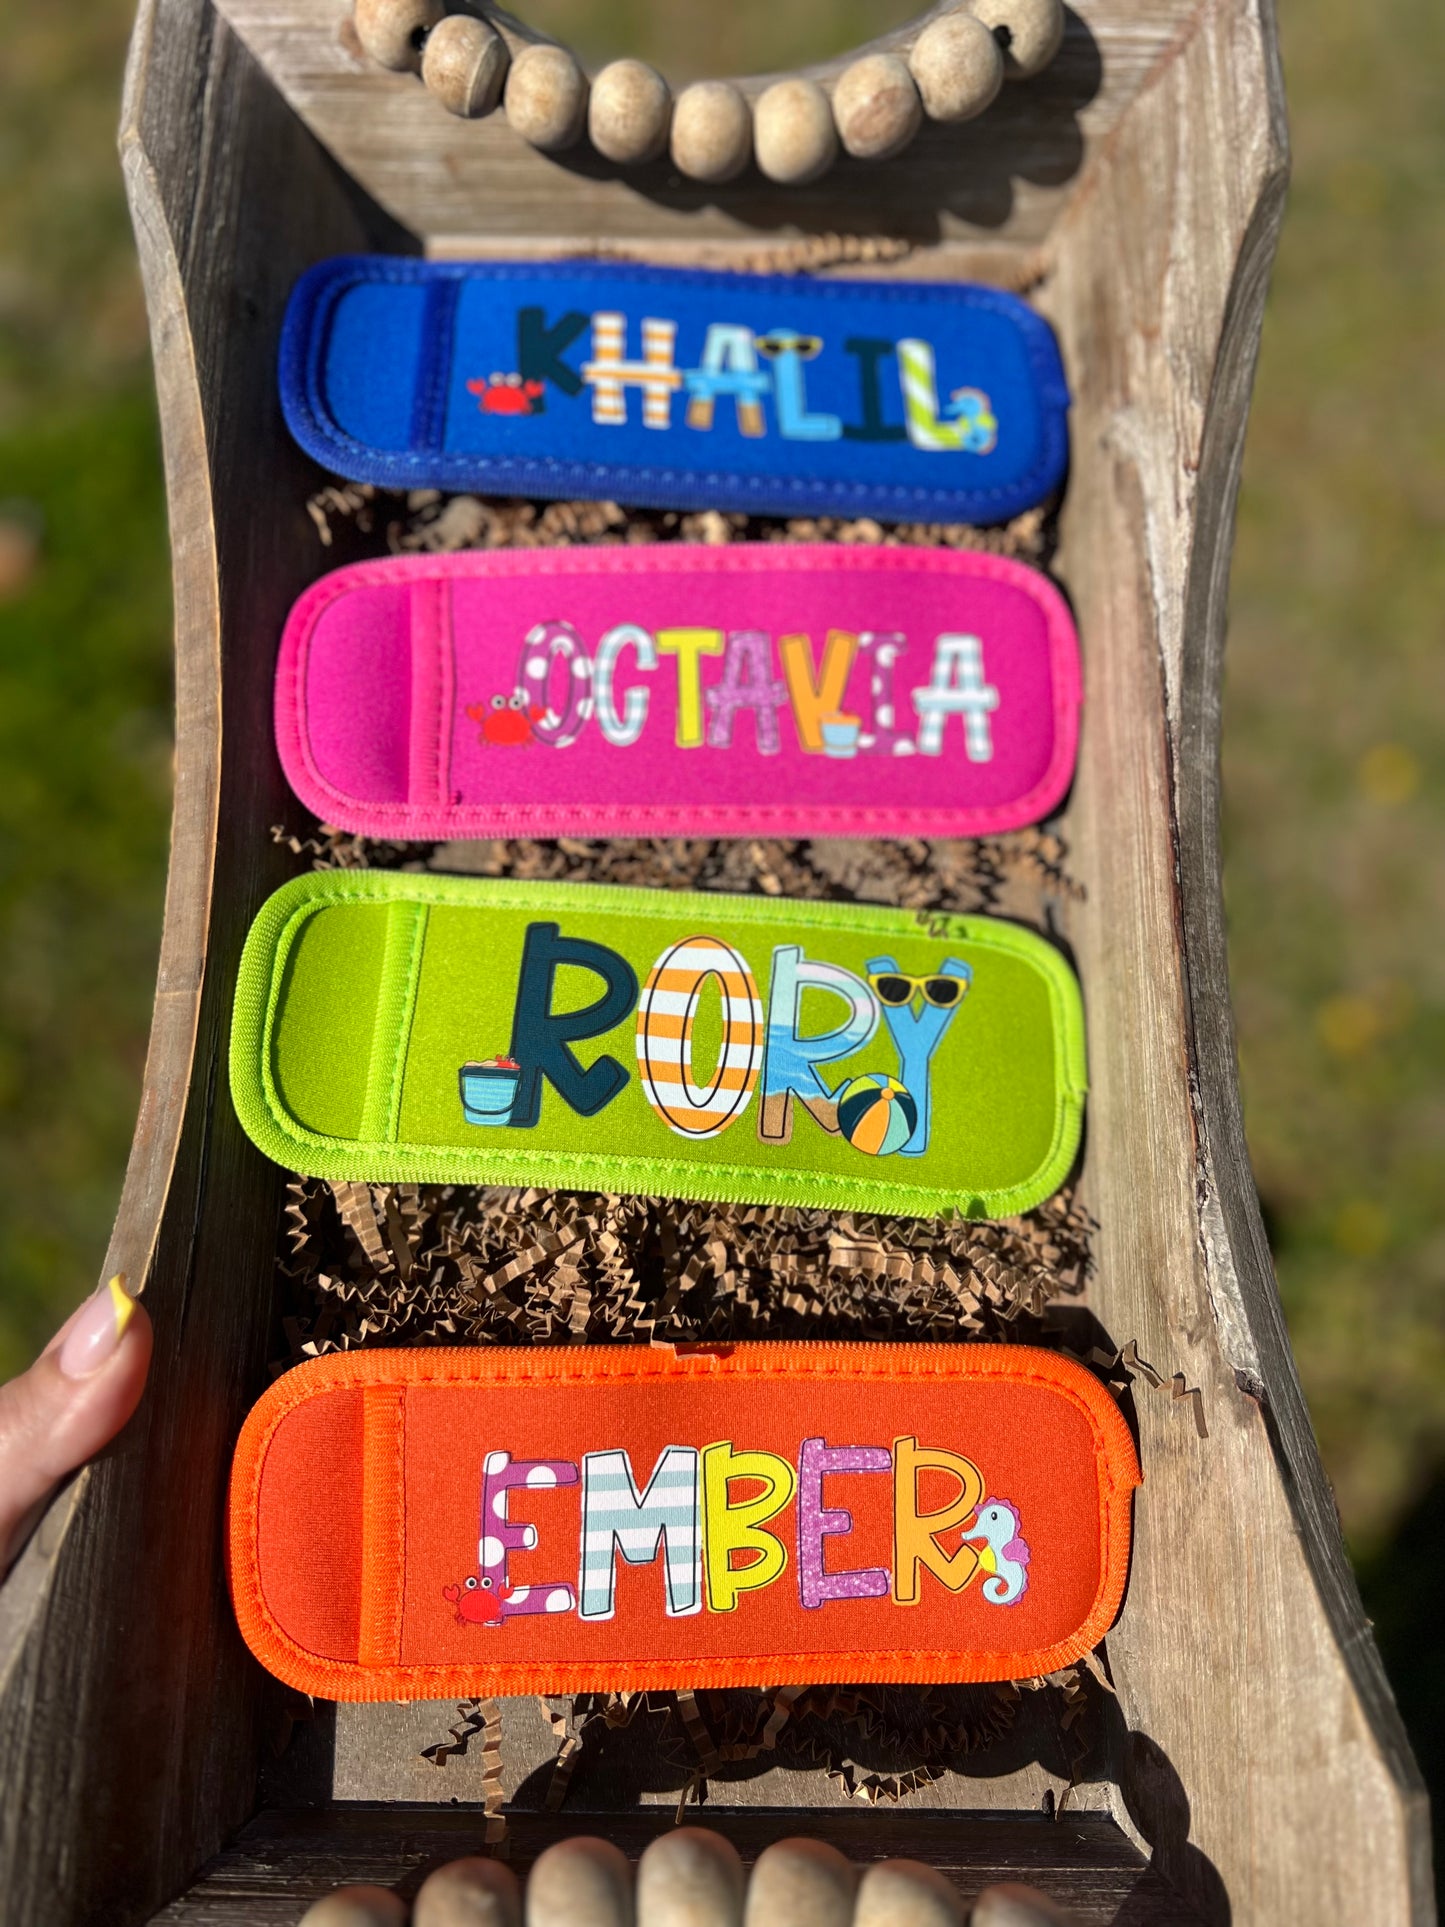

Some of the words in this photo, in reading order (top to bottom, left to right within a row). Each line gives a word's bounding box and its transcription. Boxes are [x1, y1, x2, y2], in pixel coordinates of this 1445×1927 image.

[517, 307, 990, 452] KHALIL
[516, 620, 998, 762] OCTAVIA
[507, 921, 974, 1158] RORY
[478, 1435, 985, 1624] EMBER
